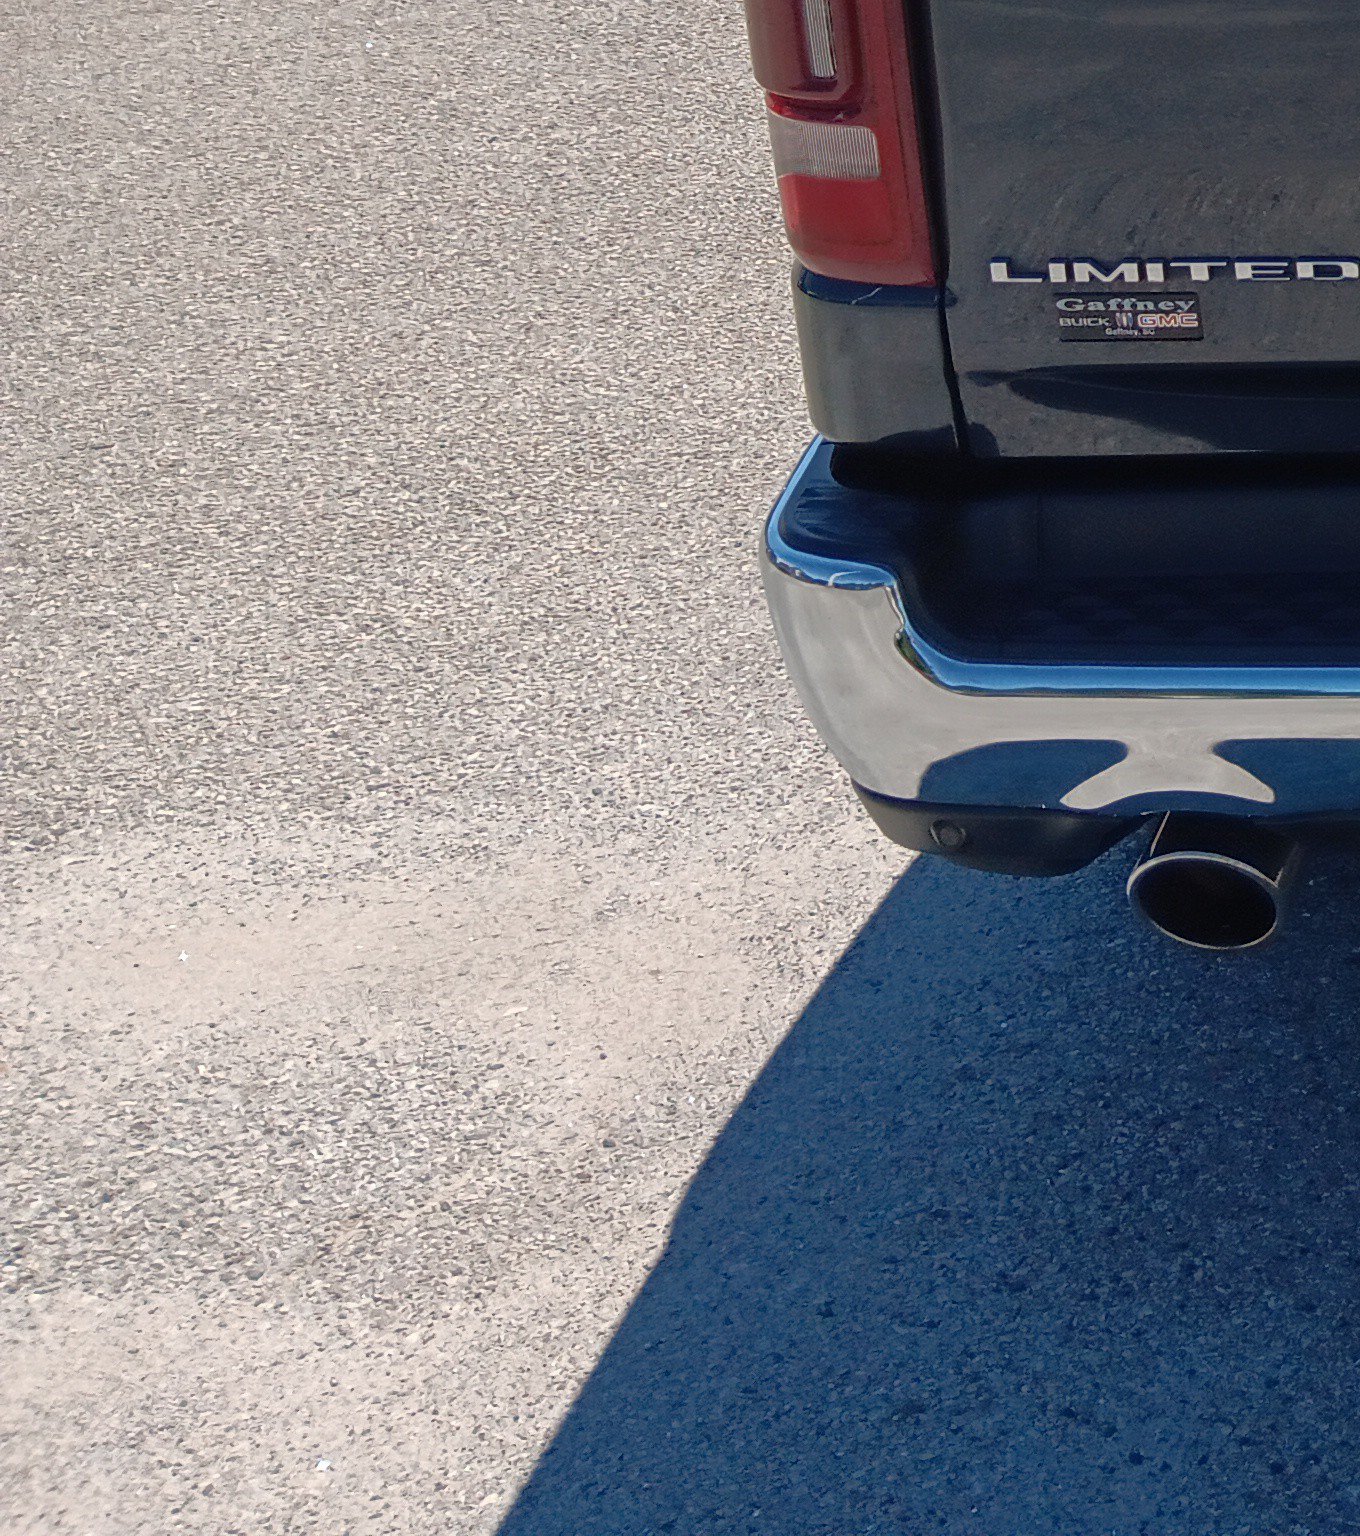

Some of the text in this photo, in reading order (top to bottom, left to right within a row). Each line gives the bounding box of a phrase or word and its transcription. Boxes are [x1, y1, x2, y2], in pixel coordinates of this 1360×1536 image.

[1056, 297, 1196, 313] Gaffney
[1059, 313, 1199, 328] BUICK GMC
